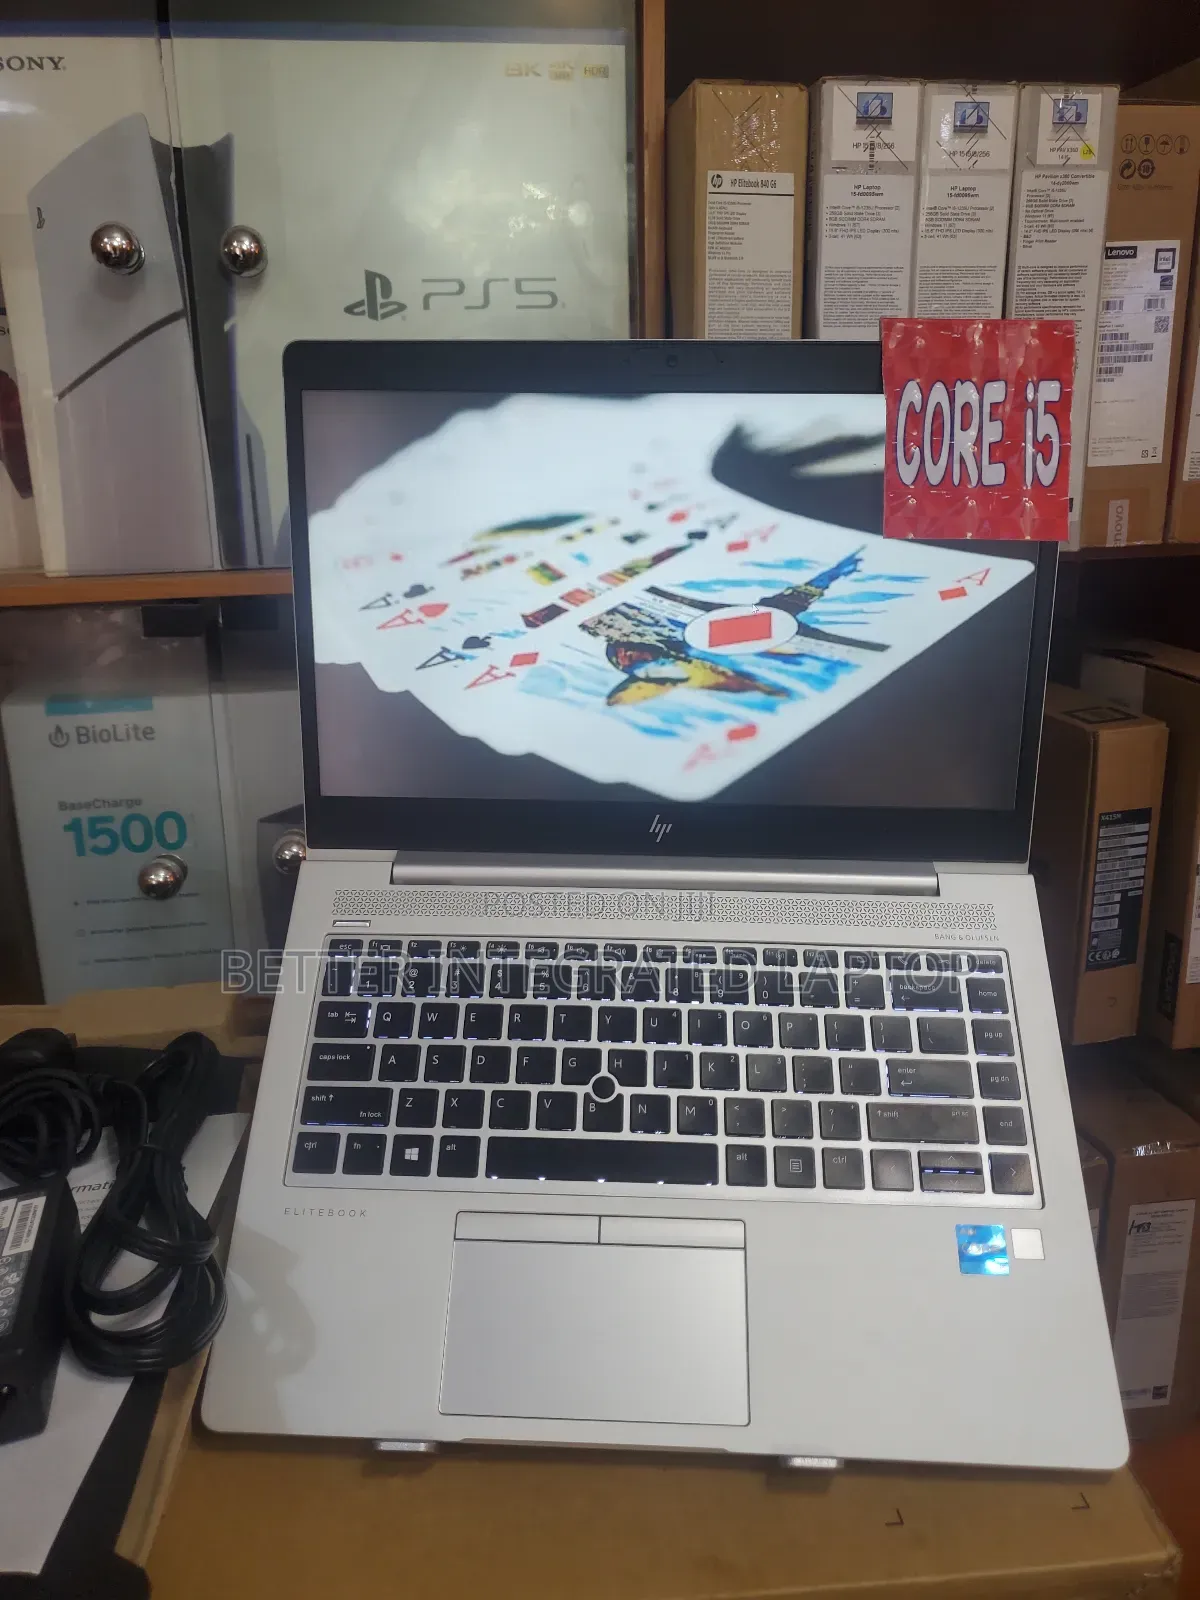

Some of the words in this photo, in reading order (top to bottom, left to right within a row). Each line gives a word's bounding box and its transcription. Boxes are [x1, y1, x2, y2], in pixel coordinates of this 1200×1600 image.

[731, 178, 737, 187] HP
[421, 277, 559, 310] PS5
[896, 379, 1007, 487] CORE
[1024, 379, 1062, 488] i5
[76, 723, 156, 745] BioLite
[63, 810, 187, 857] 1500
[934, 933, 956, 941] BANG
[408, 981, 415, 989] 2
[539, 983, 545, 991] 5
[673, 988, 679, 996] 8
[718, 989, 723, 998] 9
[762, 990, 768, 999] 0
[979, 989, 998, 997] home
[383, 1012, 392, 1022] Q
[427, 1013, 438, 1021] W
[470, 1013, 476, 1022] E
[514, 1013, 521, 1022] R
[560, 1014, 566, 1023] T
[605, 1015, 612, 1024] Y
[650, 1018, 658, 1027] U
[741, 1020, 750, 1030] O
[786, 1022, 793, 1031] P
[993, 1031, 1003, 1039] up
[388, 1056, 397, 1065] A
[432, 1056, 439, 1065] S
[477, 1056, 485, 1065] D
[523, 1057, 529, 1066] F
[568, 1058, 576, 1067] G
[614, 1059, 622, 1068] H
[663, 1061, 668, 1071] J
[708, 1062, 715, 1072] K
[755, 1064, 760, 1073] L
[1000, 1074, 1010, 1082] dn
[311, 1094, 327, 1102] shift
[406, 1098, 413, 1107] Z
[451, 1098, 458, 1107] X
[497, 1098, 504, 1108] C
[544, 1099, 551, 1108] V
[590, 1103, 596, 1112] B
[639, 1104, 647, 1114] N
[686, 1106, 696, 1116] M
[883, 1110, 899, 1118] shift
[446, 1143, 456, 1151] alt
[736, 1152, 748, 1161] alt
[832, 1156, 847, 1164] ctrl
[283, 1207, 367, 1218] ELITEBOOK
